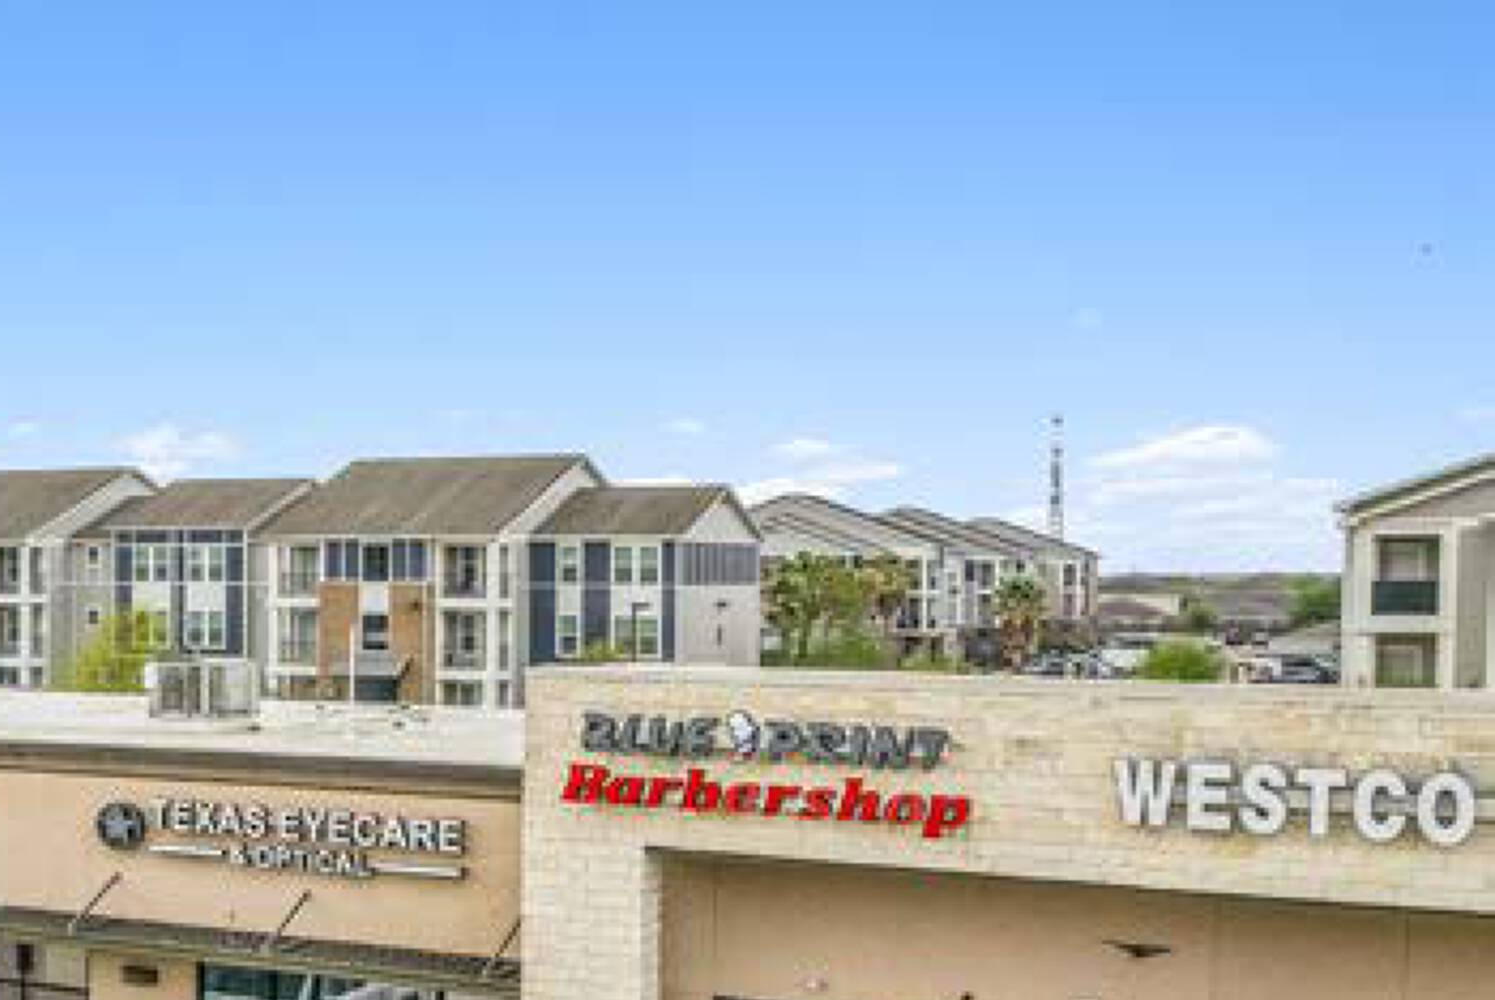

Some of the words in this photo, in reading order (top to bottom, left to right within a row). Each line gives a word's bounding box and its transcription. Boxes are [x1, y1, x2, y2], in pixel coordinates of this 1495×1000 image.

[582, 712, 718, 757] BLUE
[765, 721, 952, 771] PRINT
[153, 799, 269, 839] TEXAS
[280, 806, 466, 852] EYECARE
[561, 764, 971, 839] Barbershop
[1113, 758, 1477, 845] WESTCO
[254, 845, 374, 877] OPTICAL
